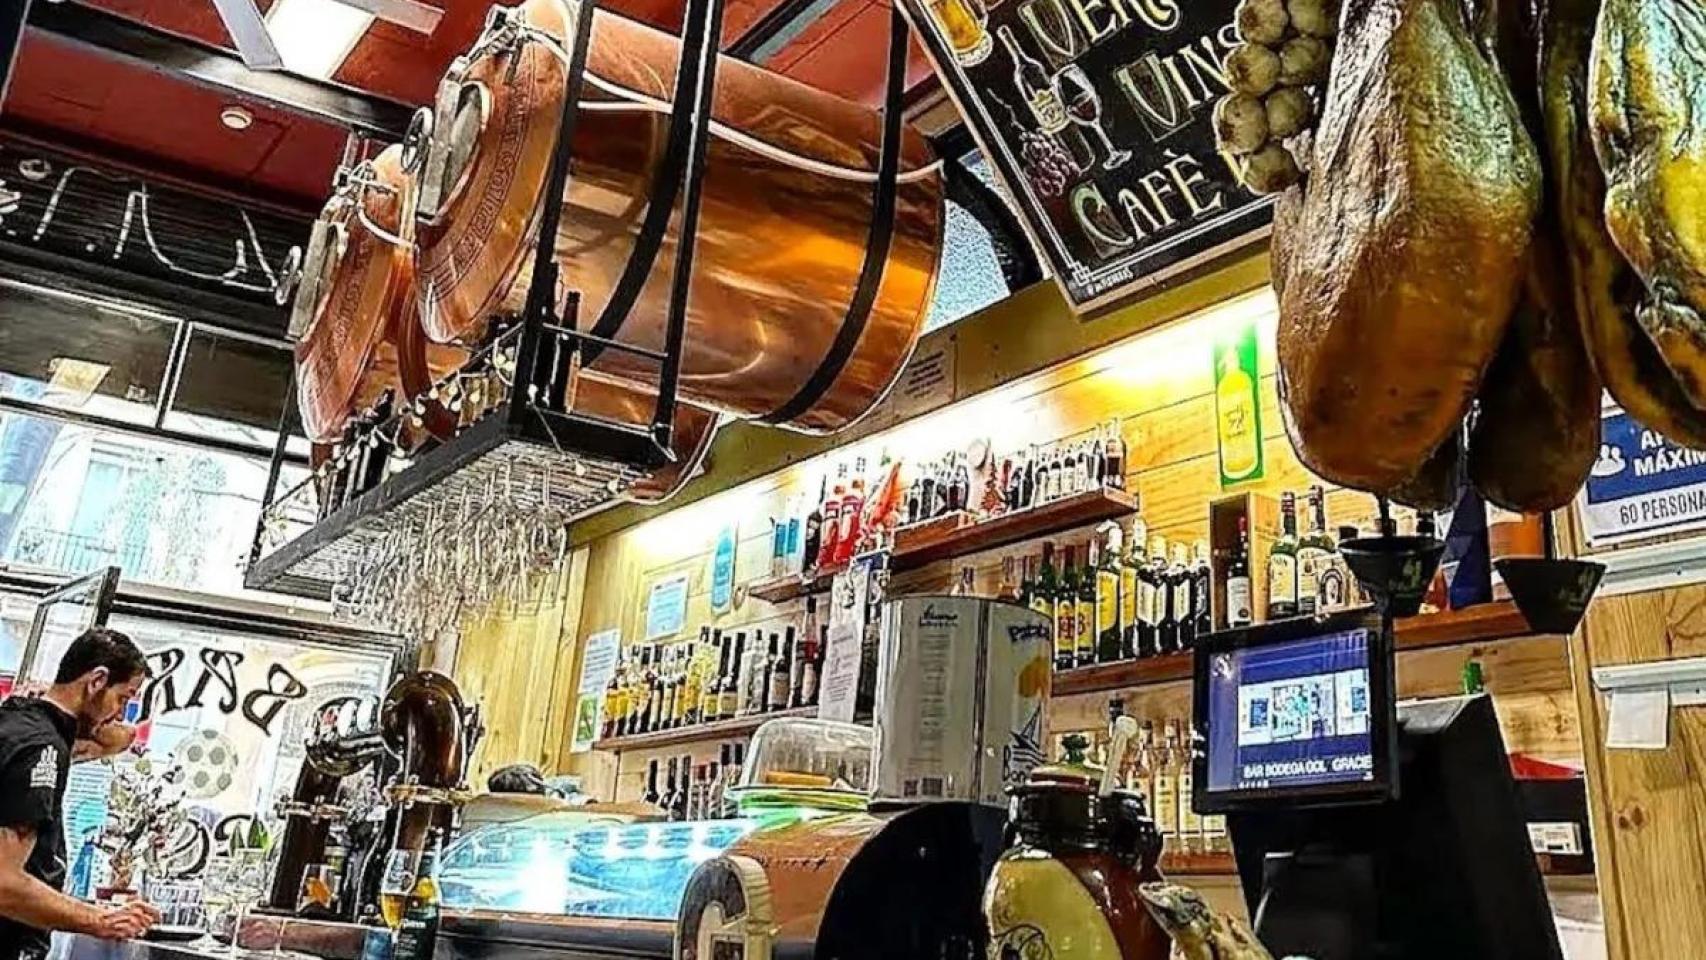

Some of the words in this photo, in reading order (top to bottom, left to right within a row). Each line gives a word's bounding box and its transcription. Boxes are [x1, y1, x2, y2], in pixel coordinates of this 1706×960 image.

[1071, 149, 1222, 246] CAFÈ
[1619, 502, 1639, 525] 60
[1243, 763, 1264, 779] BAR
